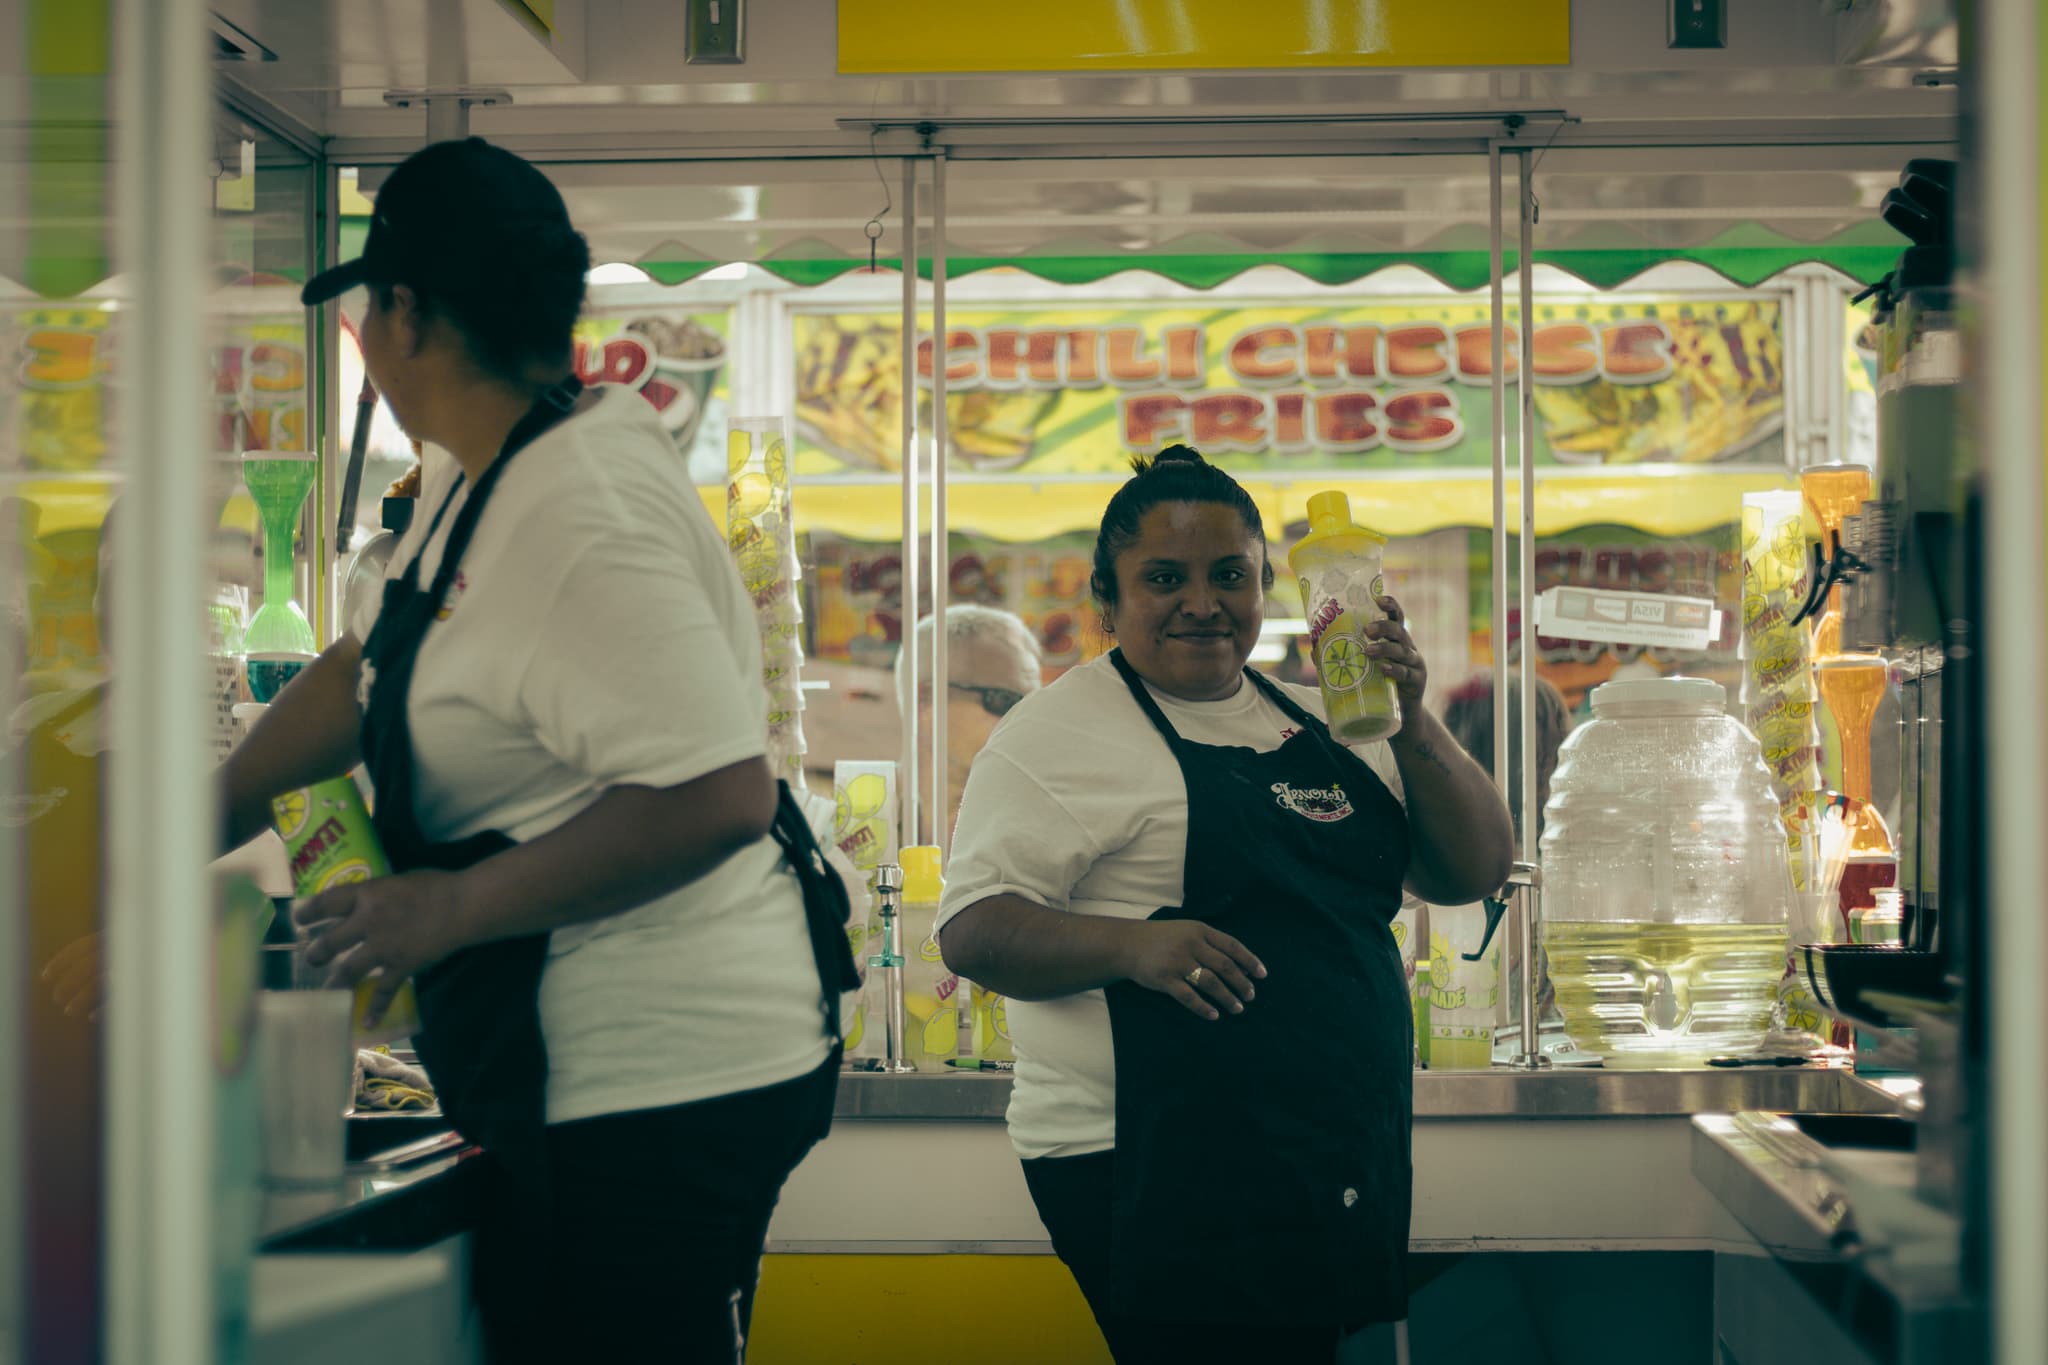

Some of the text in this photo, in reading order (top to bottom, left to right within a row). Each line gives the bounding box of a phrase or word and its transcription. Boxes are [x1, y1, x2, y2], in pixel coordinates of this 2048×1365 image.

[914, 324, 1671, 384] CHILI CHEESE
[1123, 391, 1457, 447] FRIES
